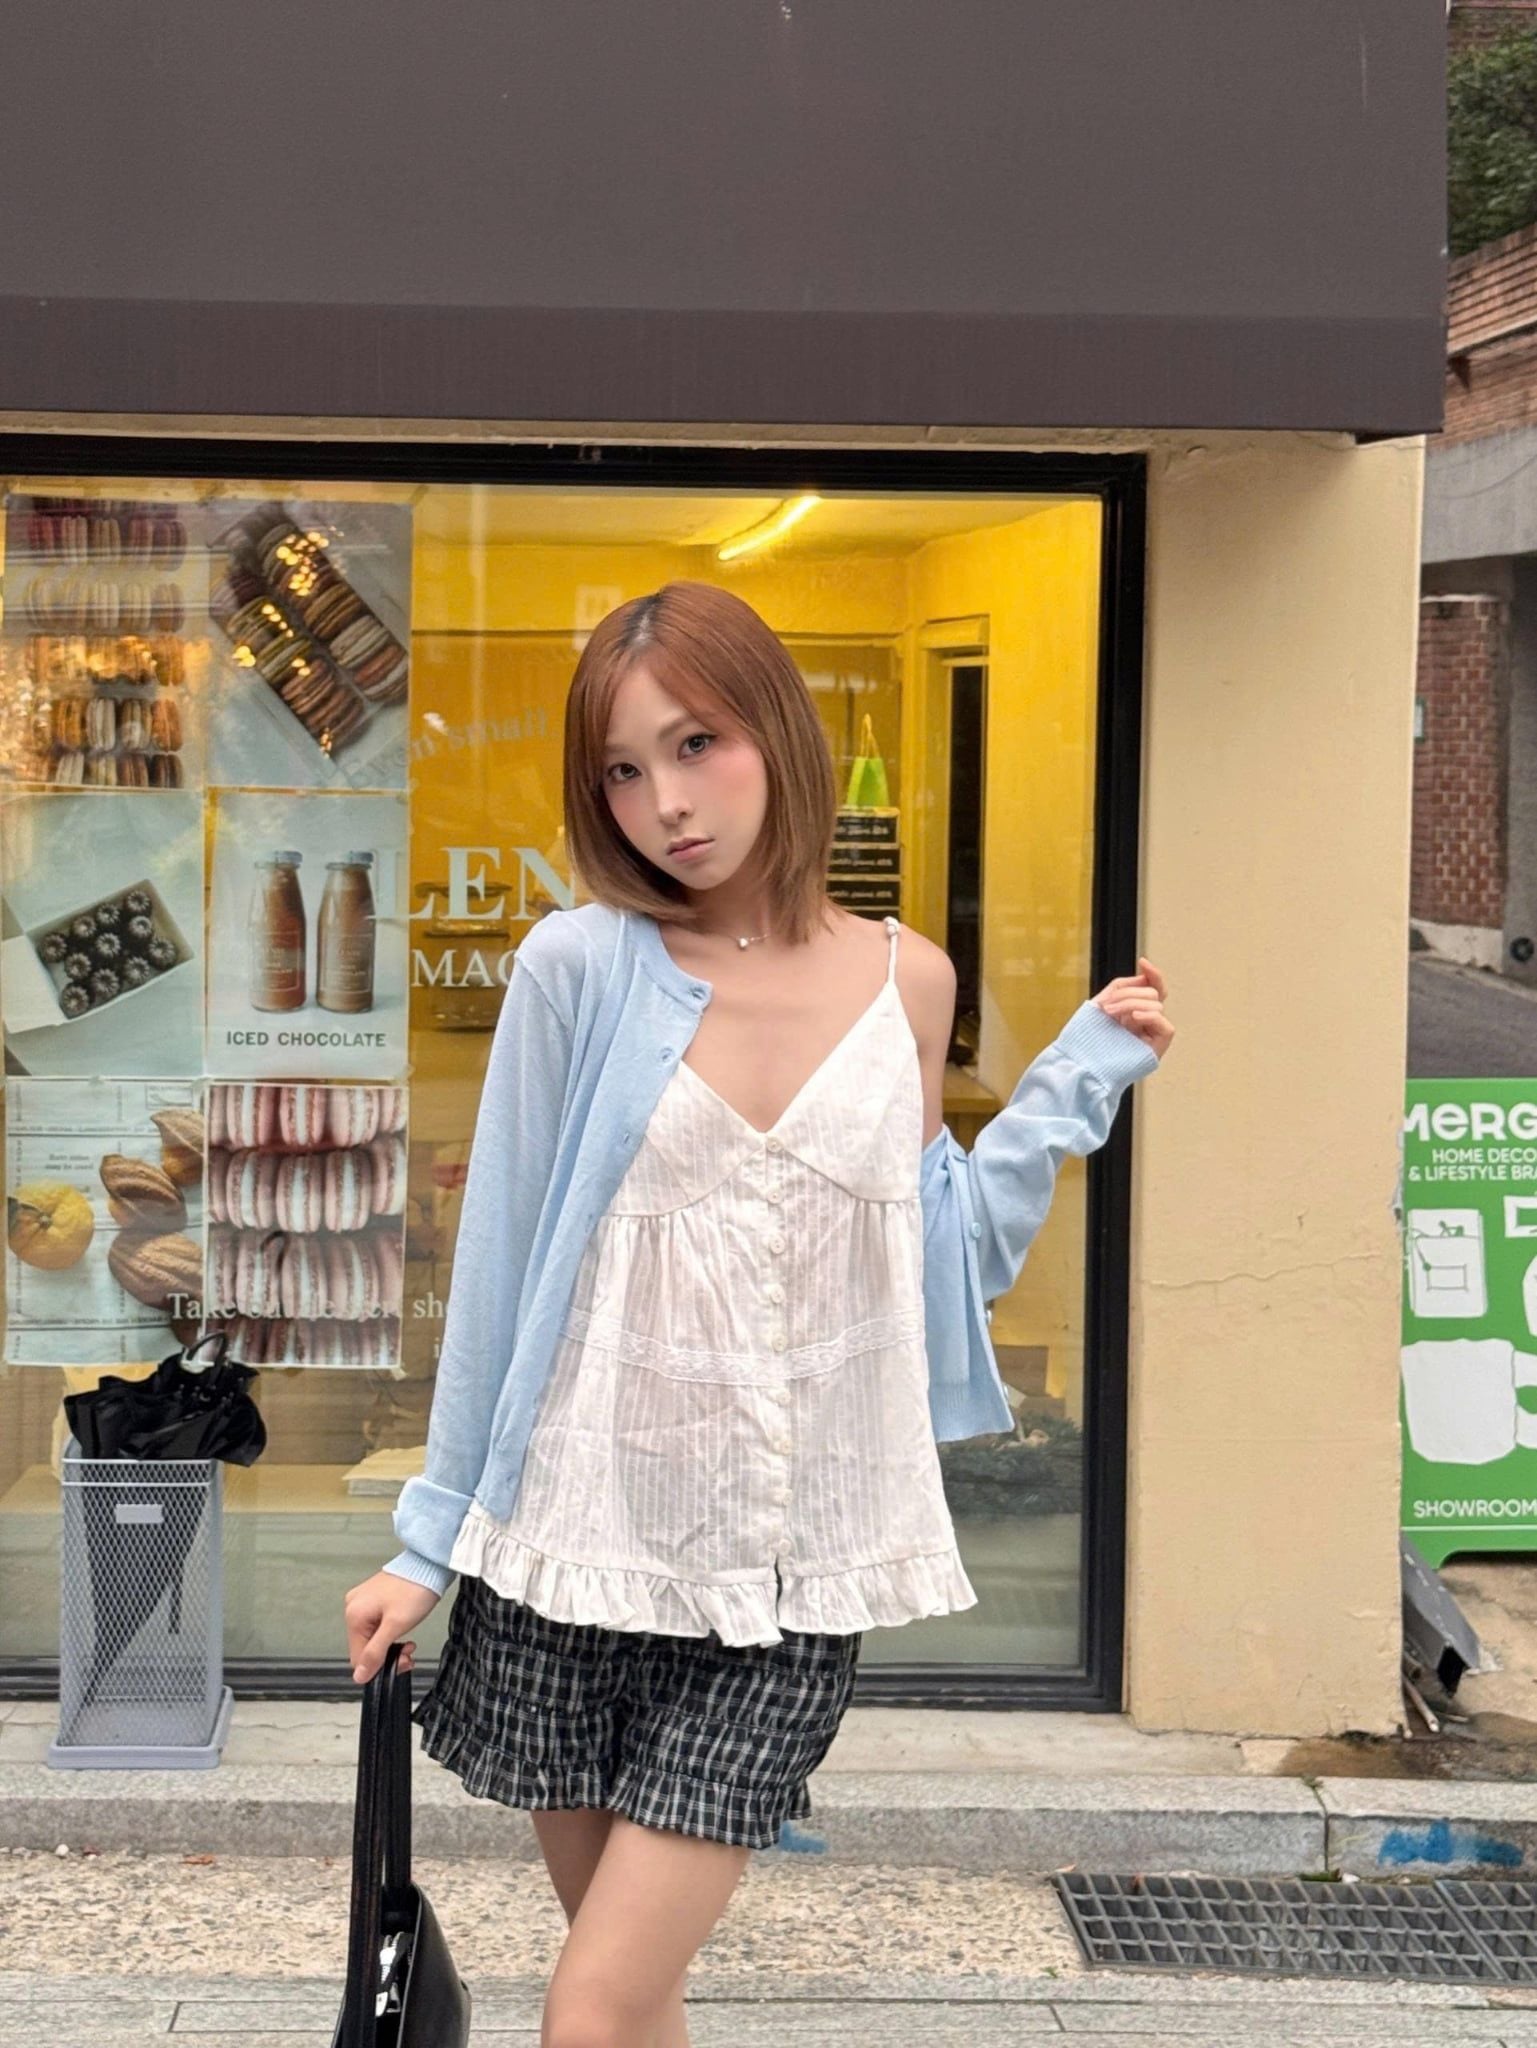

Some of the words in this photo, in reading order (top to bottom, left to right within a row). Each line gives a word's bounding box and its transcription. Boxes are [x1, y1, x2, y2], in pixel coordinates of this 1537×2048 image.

[227, 1031, 269, 1046] ICED
[278, 1032, 386, 1047] CHOCOLATE
[1432, 1148, 1484, 1164] HOME
[1487, 1147, 1537, 1164] DECO
[1408, 1165, 1422, 1181] &
[1424, 1164, 1507, 1181] LIFESTYLE
[413, 1290, 449, 1319] sh
[1412, 1498, 1537, 1519] SHOWROOM
